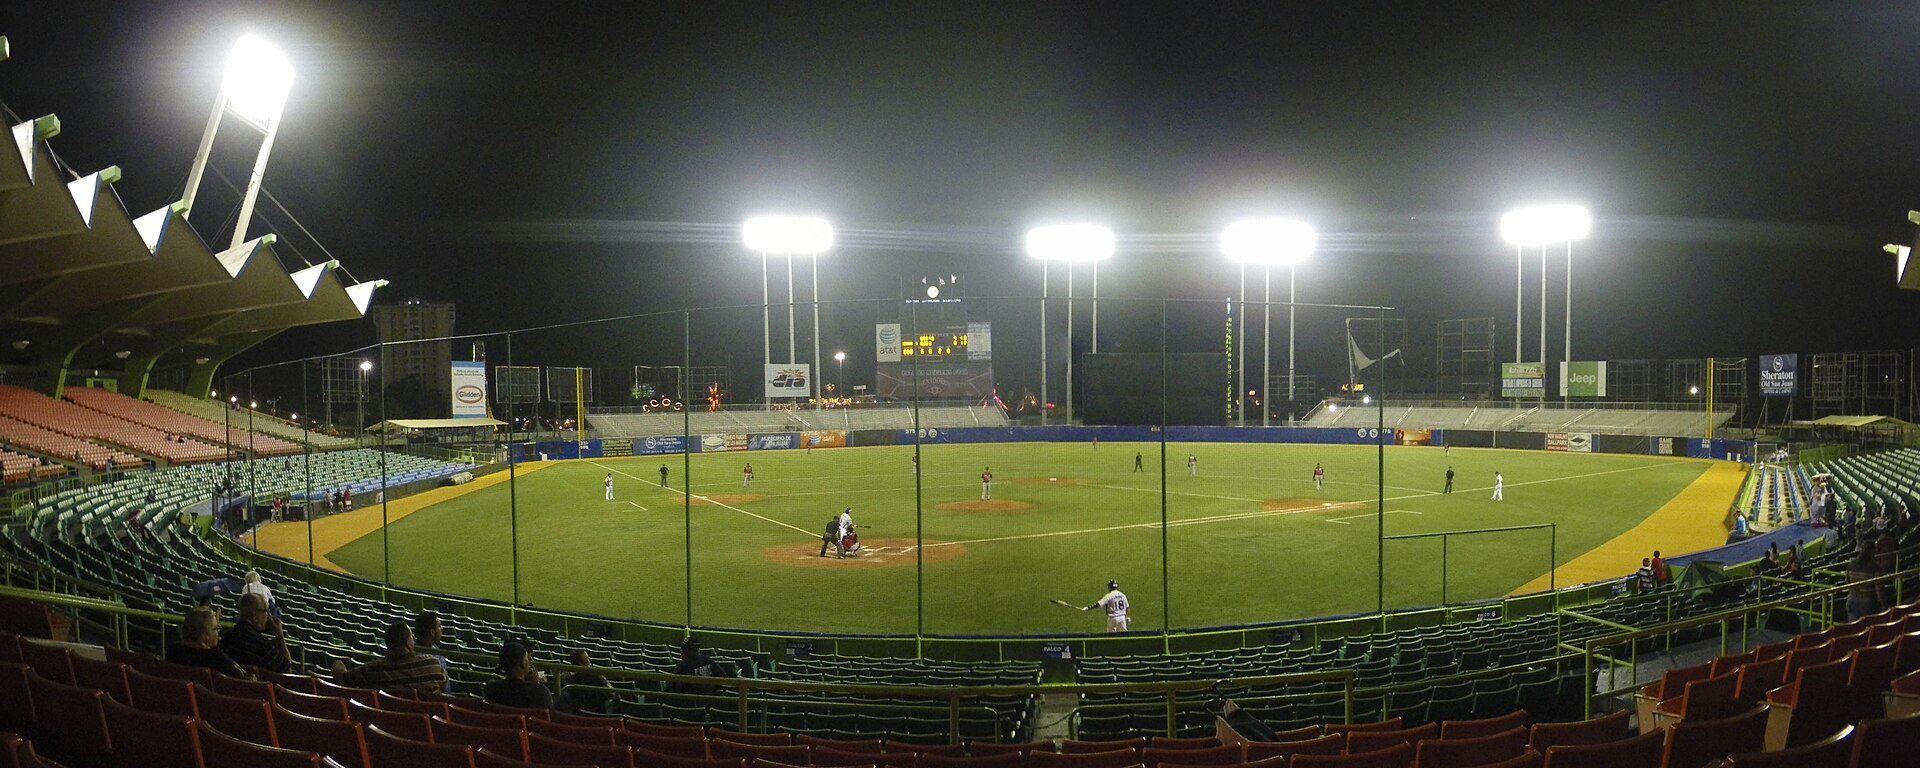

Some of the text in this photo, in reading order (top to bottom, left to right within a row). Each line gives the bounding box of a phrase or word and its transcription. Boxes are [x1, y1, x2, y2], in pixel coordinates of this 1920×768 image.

[880, 346, 897, 354] at&t
[1570, 372, 1596, 384] Jeep
[1762, 371, 1793, 380] Sheraton
[1114, 600, 1124, 611] 18
